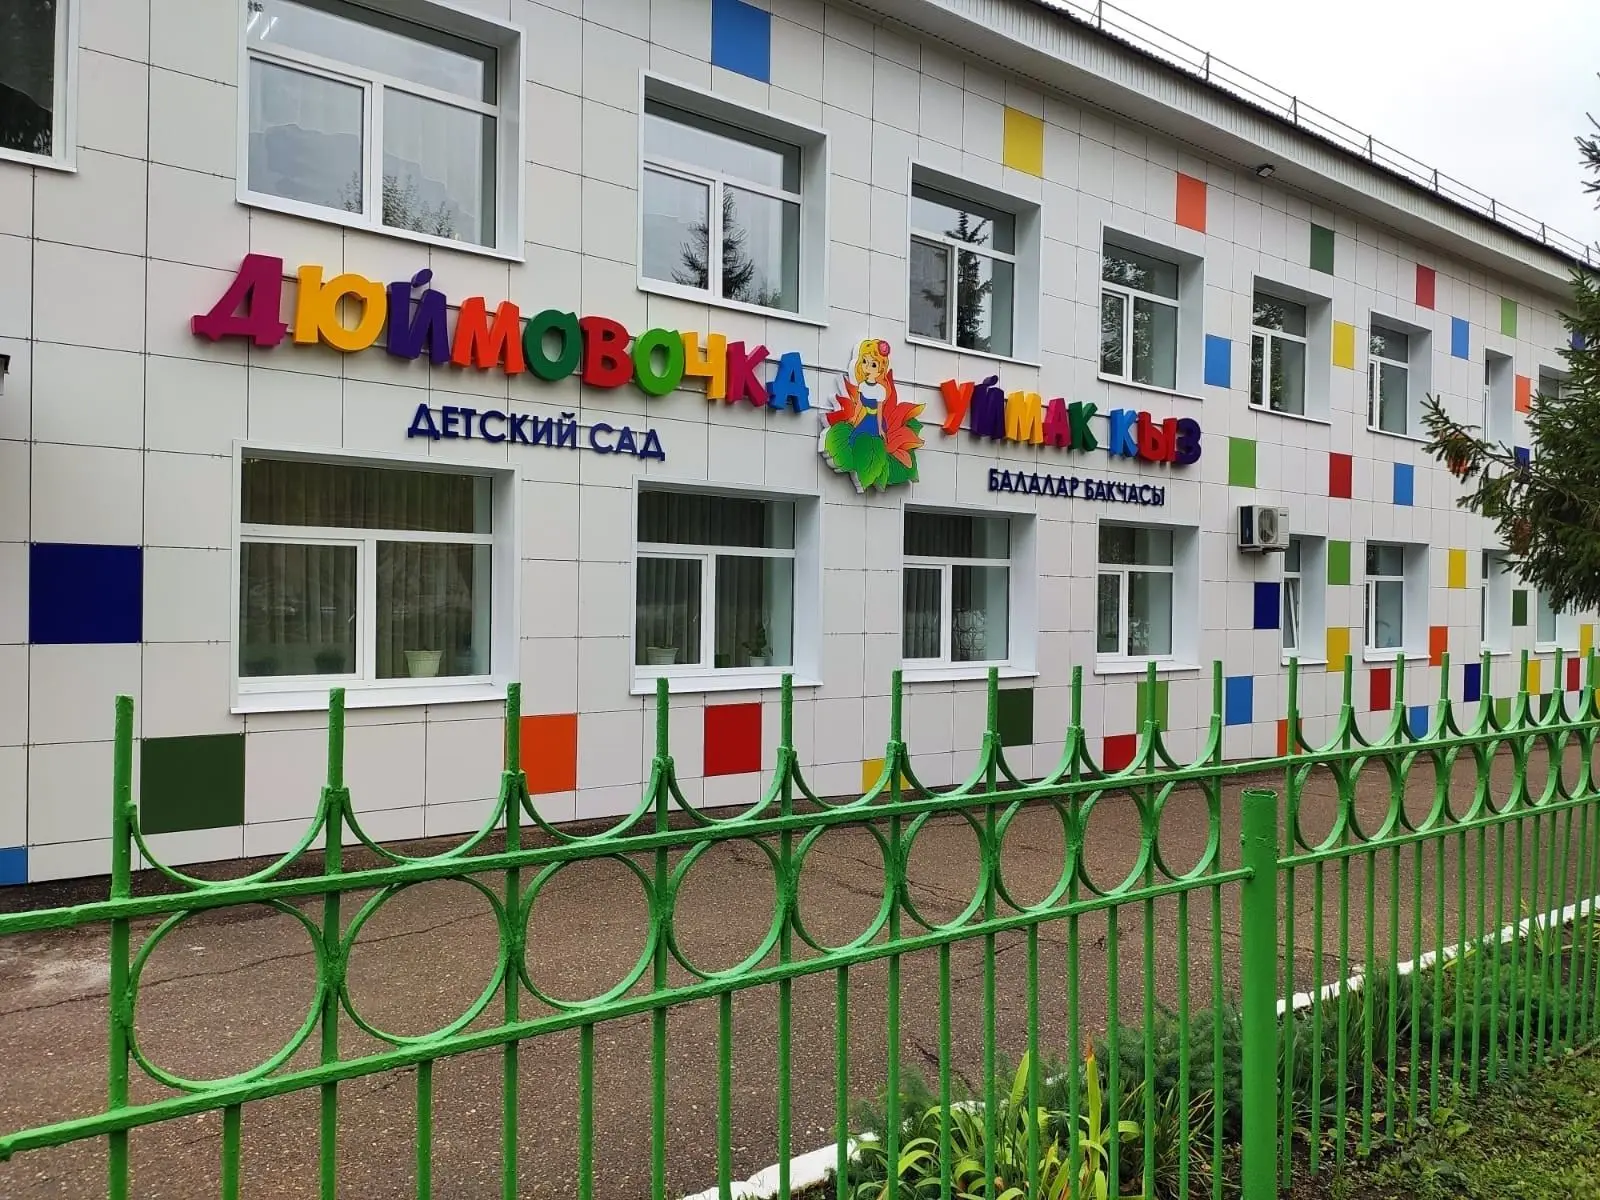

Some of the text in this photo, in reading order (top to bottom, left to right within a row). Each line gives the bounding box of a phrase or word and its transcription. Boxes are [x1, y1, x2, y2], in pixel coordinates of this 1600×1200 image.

[191, 253, 811, 414] ДЮЙМОВОЧКА
[407, 403, 666, 462] ДЕТСКИЙ САД
[940, 375, 1202, 465] УЙМАК КЫЗ
[987, 468, 1165, 506] БАЛАЛАР БАКЧАСЫ
